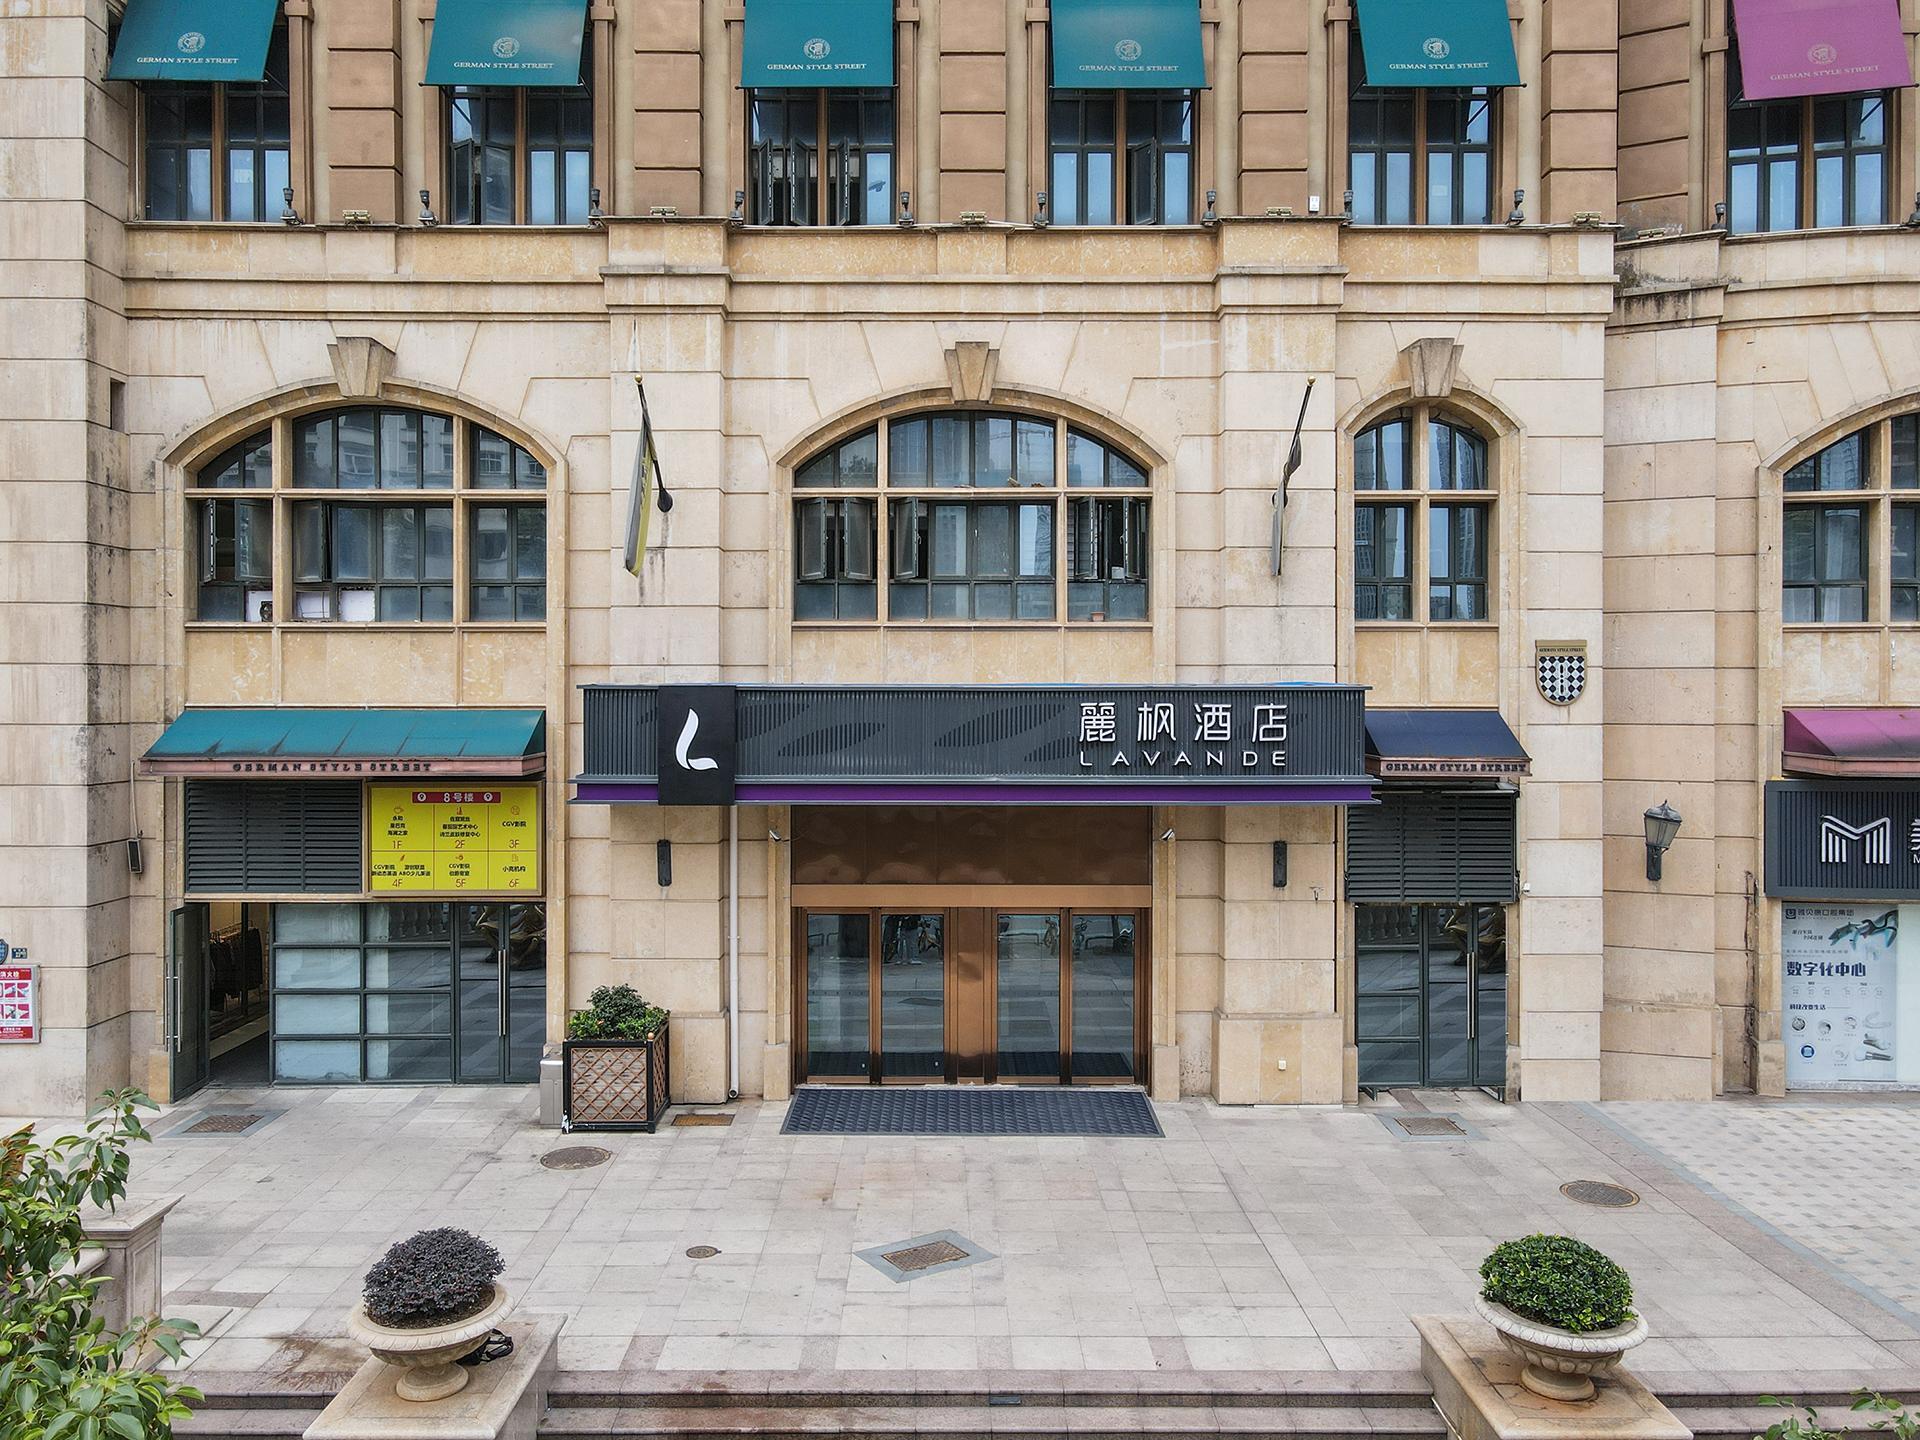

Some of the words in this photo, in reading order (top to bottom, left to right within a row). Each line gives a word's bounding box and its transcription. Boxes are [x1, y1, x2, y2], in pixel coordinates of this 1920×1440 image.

[453, 61, 491, 69] GERMAN
[1079, 701, 1288, 743] 麗枫酒店
[1079, 750, 1286, 767] LAVANDE
[232, 763, 302, 772] GERMAN
[309, 763, 363, 772] STYLE
[369, 763, 432, 772] STREET
[1385, 763, 1438, 772] GERMAN
[1439, 763, 1478, 772] STYLE
[1480, 763, 1526, 772] STREET
[392, 840, 403, 849] 1F
[454, 839, 466, 849] 2F
[508, 839, 520, 849] 3F
[392, 879, 403, 888] 4F
[455, 878, 466, 888] 5F
[508, 878, 520, 888] 6F
[1786, 961, 1867, 977] 数字化中心
